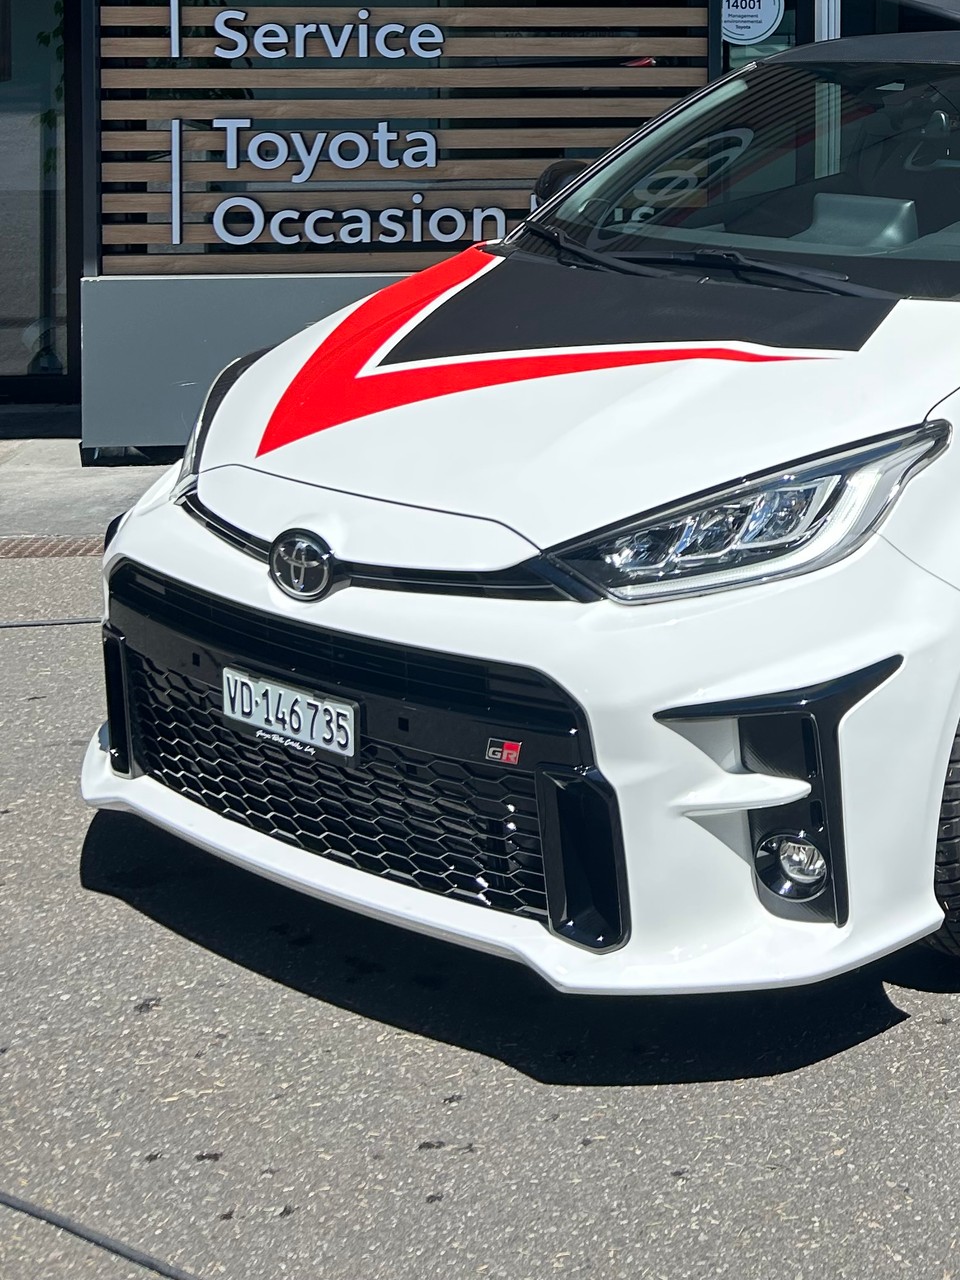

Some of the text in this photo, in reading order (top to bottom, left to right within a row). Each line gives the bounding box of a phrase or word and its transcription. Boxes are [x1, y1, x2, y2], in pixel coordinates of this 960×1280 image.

[213, 9, 445, 59] Service
[212, 118, 438, 183] Toyota
[212, 192, 507, 246] Occasion
[487, 745, 518, 763] GR
